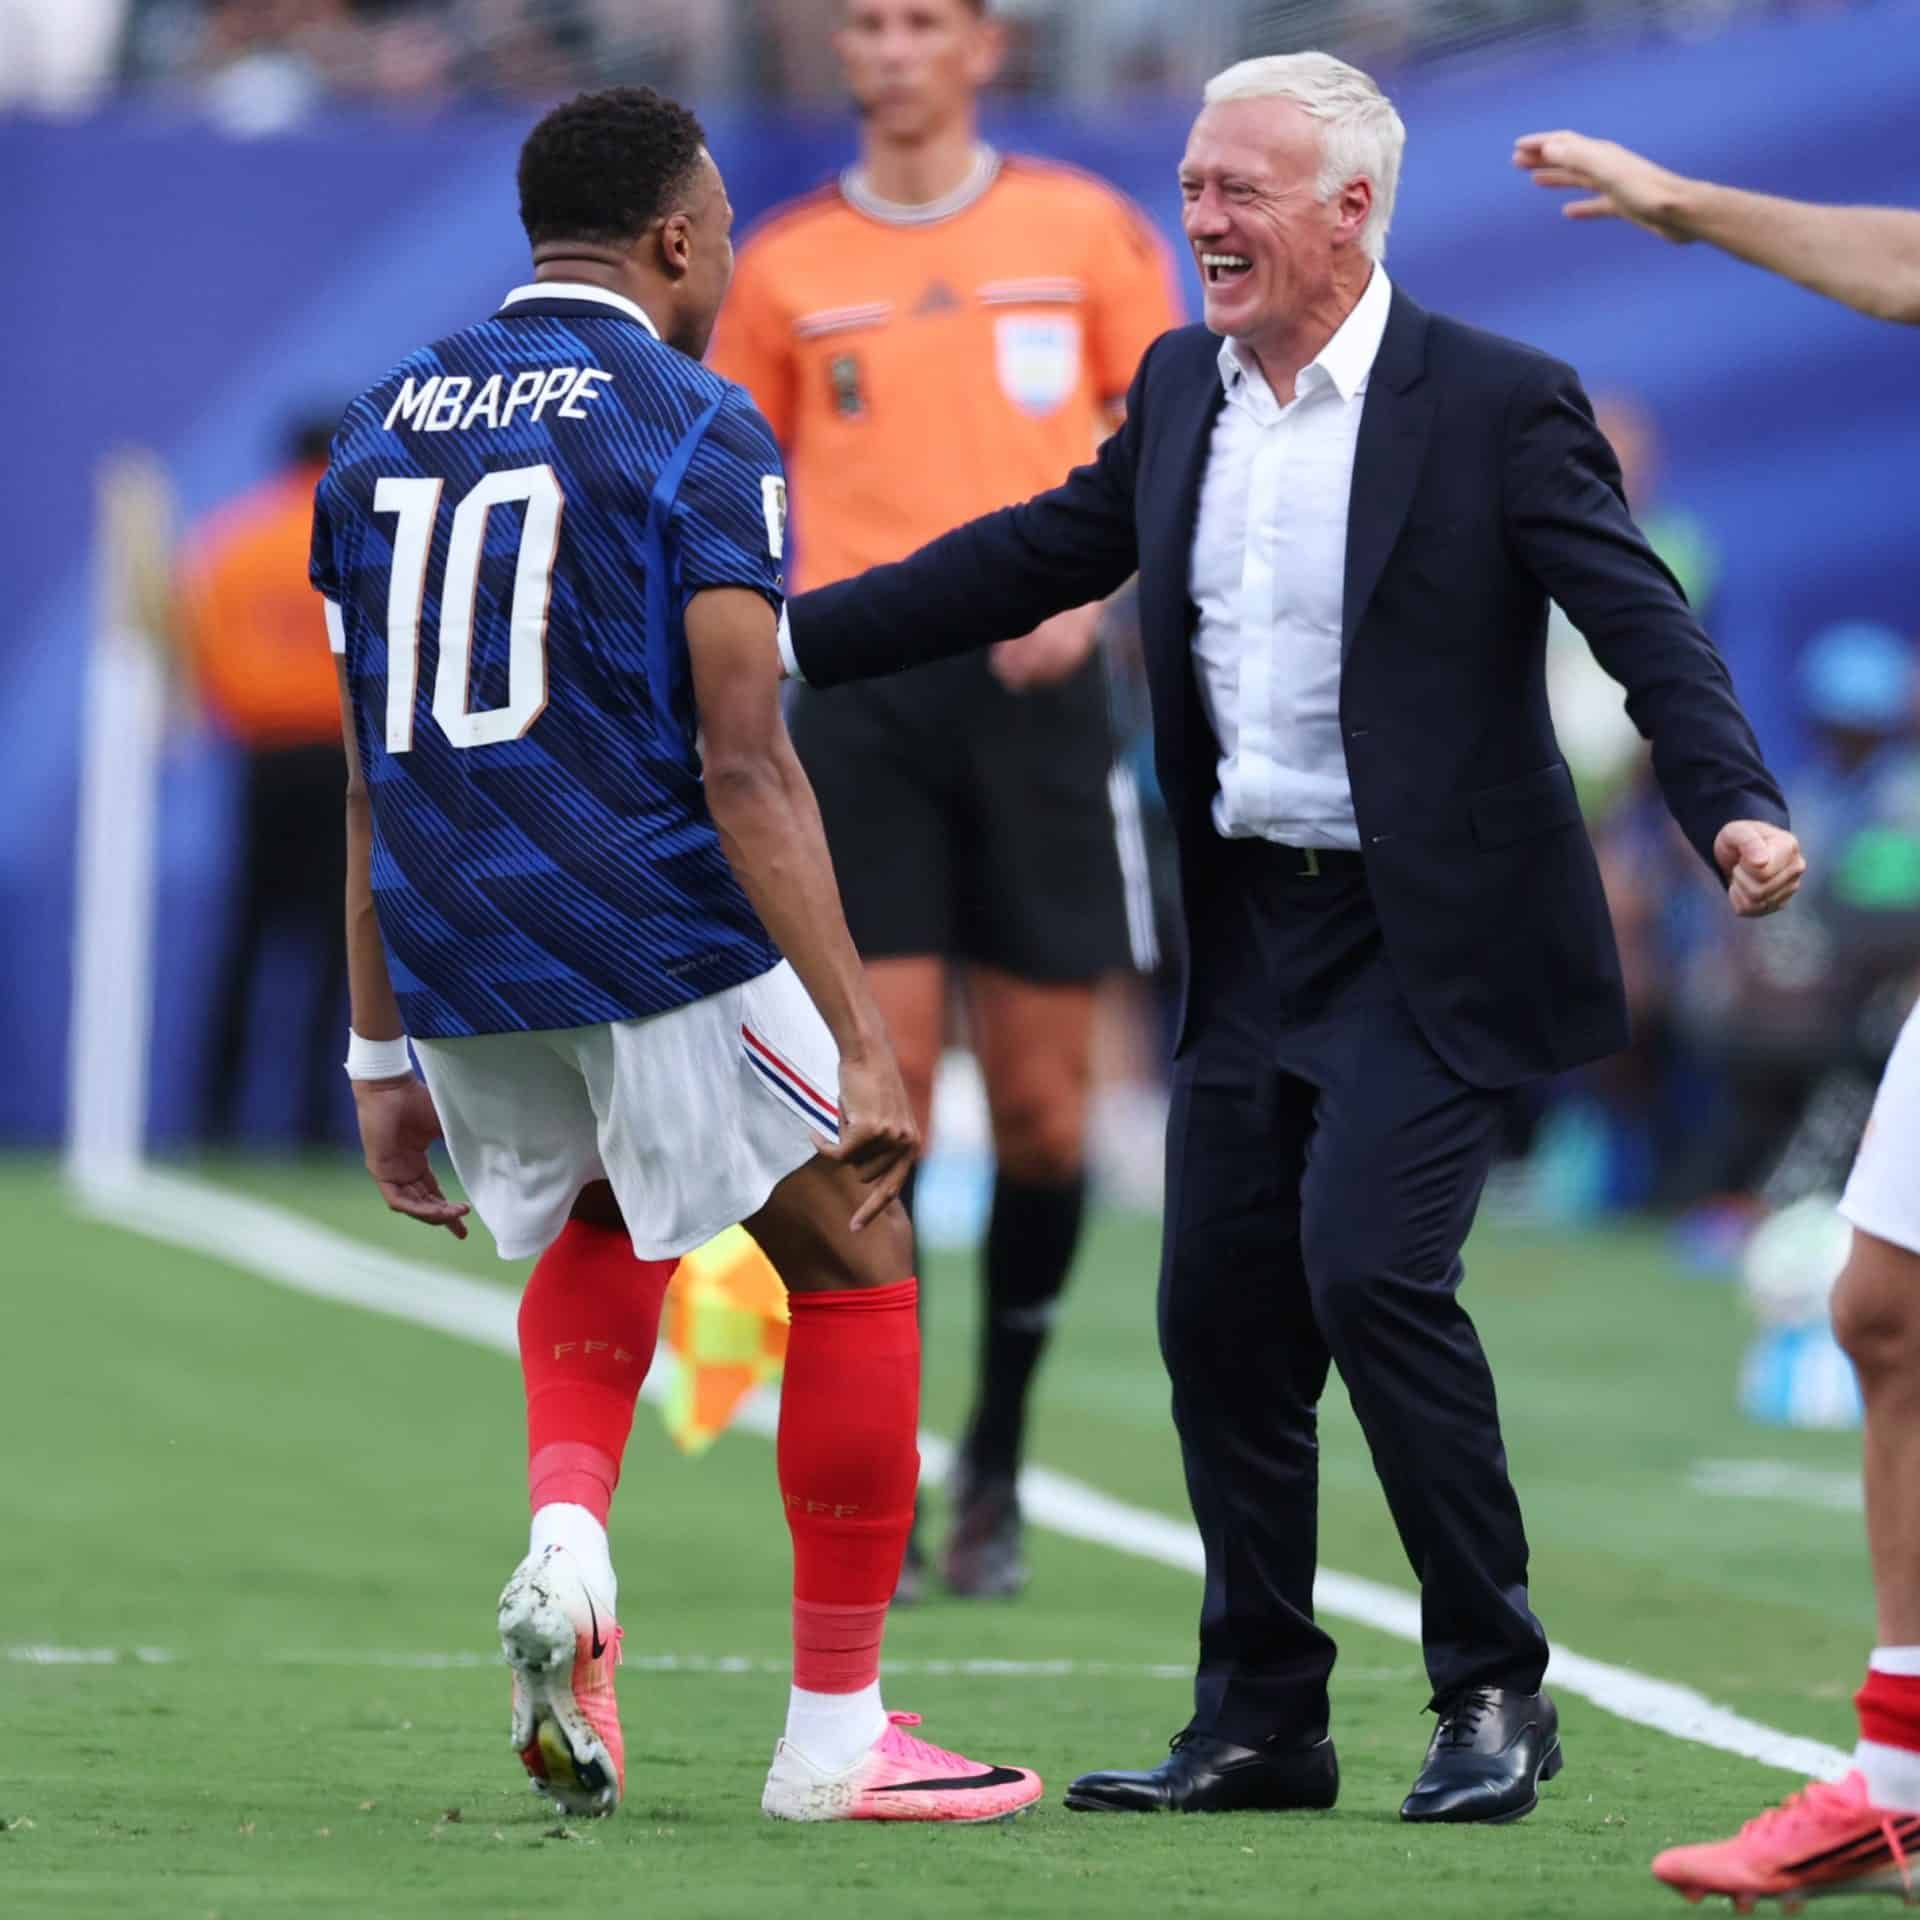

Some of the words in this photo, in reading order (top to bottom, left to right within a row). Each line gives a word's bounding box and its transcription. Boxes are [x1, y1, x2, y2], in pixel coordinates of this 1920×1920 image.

[383, 367, 613, 432] MBAPPE
[373, 463, 565, 754] 10
[553, 1338, 633, 1363] FFF
[785, 1492, 860, 1519] FFF
